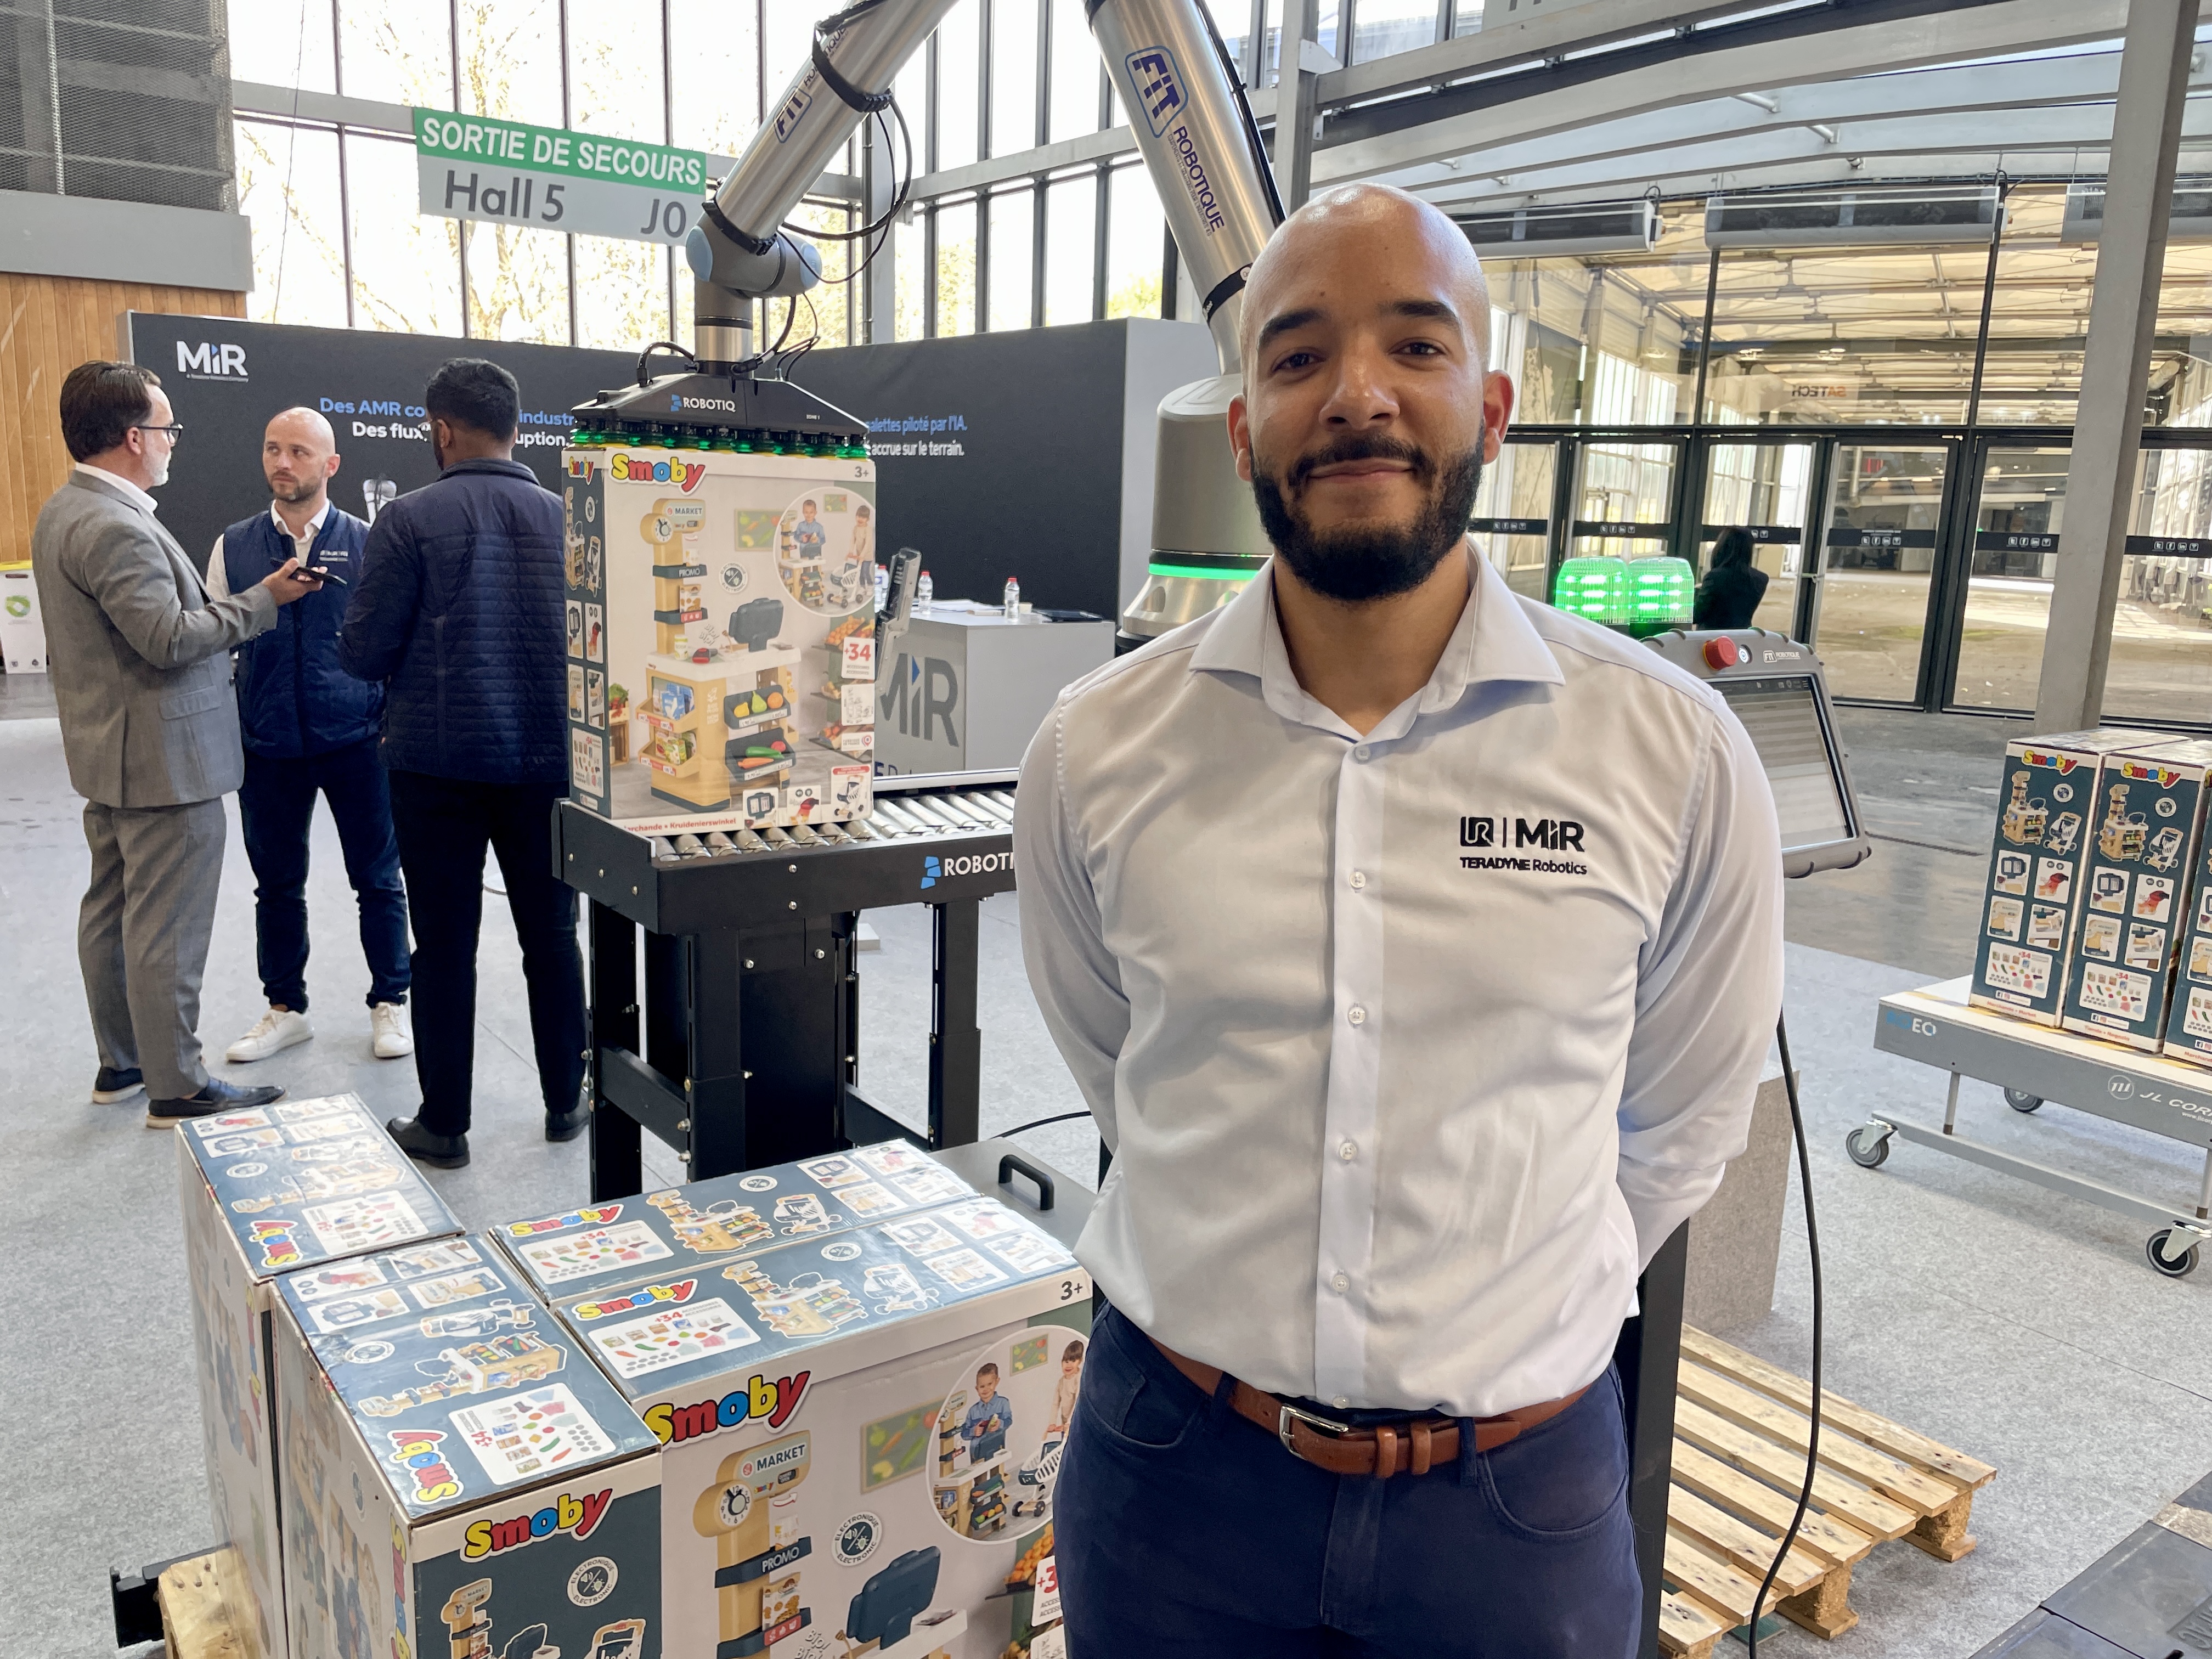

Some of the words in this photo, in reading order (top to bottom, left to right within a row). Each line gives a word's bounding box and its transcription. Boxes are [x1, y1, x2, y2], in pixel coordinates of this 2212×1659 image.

[421, 117, 527, 161] SORTIE
[533, 134, 571, 167] DE
[577, 141, 702, 186] SECOURS
[1173, 126, 1224, 232] ROBOTIQUE
[444, 169, 532, 219] Hall
[541, 183, 565, 222] 5
[177, 341, 249, 376] MiR
[320, 397, 355, 415] Des
[359, 399, 401, 416] AMR
[404, 404, 426, 418] co
[519, 409, 574, 426] industr
[683, 397, 736, 413] ROBOTIQ
[353, 421, 387, 438] Des
[516, 431, 569, 449] uption.
[868, 417, 901, 432] alettes
[930, 419, 947, 436] par
[871, 443, 901, 456] accrue
[902, 443, 918, 456] sur
[918, 439, 927, 456] le
[929, 439, 965, 456] terrain.
[568, 456, 594, 483] Smoby
[612, 453, 706, 492] Smoby
[855, 466, 868, 478] 3+
[679, 568, 701, 577] PROMO
[844, 643, 871, 662] +34
[2024, 750, 2078, 774] Smoby
[2123, 762, 2181, 788] Smoby
[670, 817, 736, 830] Kruidenierswinkel
[1516, 818, 1585, 852] MiR
[944, 851, 1015, 877] ROBOTI
[1460, 857, 1530, 871] TERADYNE
[1533, 859, 1587, 875] Robotics
[2184, 1051, 2212, 1063] Marchand
[2140, 1092, 2162, 1103] JL
[2169, 1099, 2212, 1116] COR
[510, 1206, 620, 1235] Smoby
[253, 1222, 299, 1266] Smoby
[577, 1280, 694, 1318] Smoby
[1061, 1281, 1083, 1300] 3+
[655, 1311, 683, 1322] +34
[642, 1370, 811, 1446] Smoby
[392, 1431, 459, 1502] Smoby
[757, 1444, 805, 1471] MARKET
[465, 1488, 613, 1558] Smoby
[835, 1514, 879, 1541] ELECTRONIQUE
[761, 1547, 799, 1573] PROMO
[837, 1541, 877, 1564] ELECTRONIC
[571, 1559, 614, 1584] ELECTRONIQUE
[1037, 1565, 1059, 1593] +3
[467, 1585, 488, 1597] MARKET
[573, 1583, 613, 1605] ELECTRONIC
